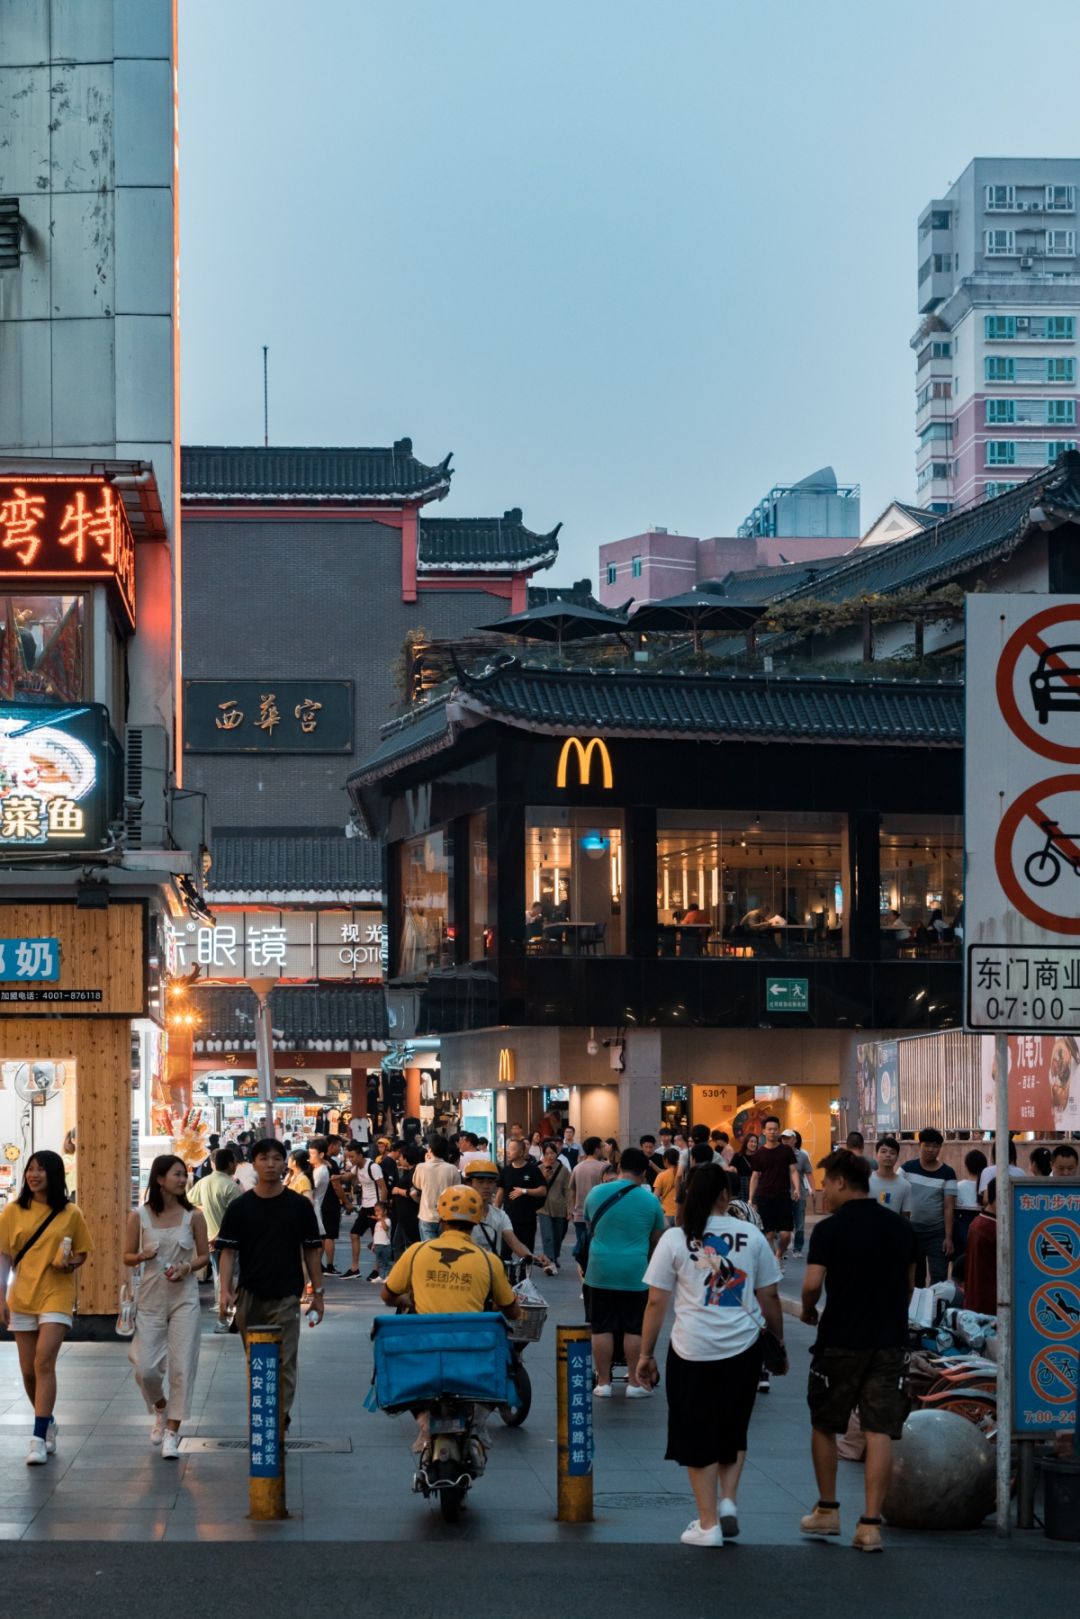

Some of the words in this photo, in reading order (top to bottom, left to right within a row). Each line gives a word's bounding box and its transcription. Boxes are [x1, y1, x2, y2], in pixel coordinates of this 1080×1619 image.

[425, 1270, 472, 1285] 美团外卖
[251, 1357, 263, 1466] 公安反恐路桩
[571, 1355, 585, 1463] 公安反恐路桩
